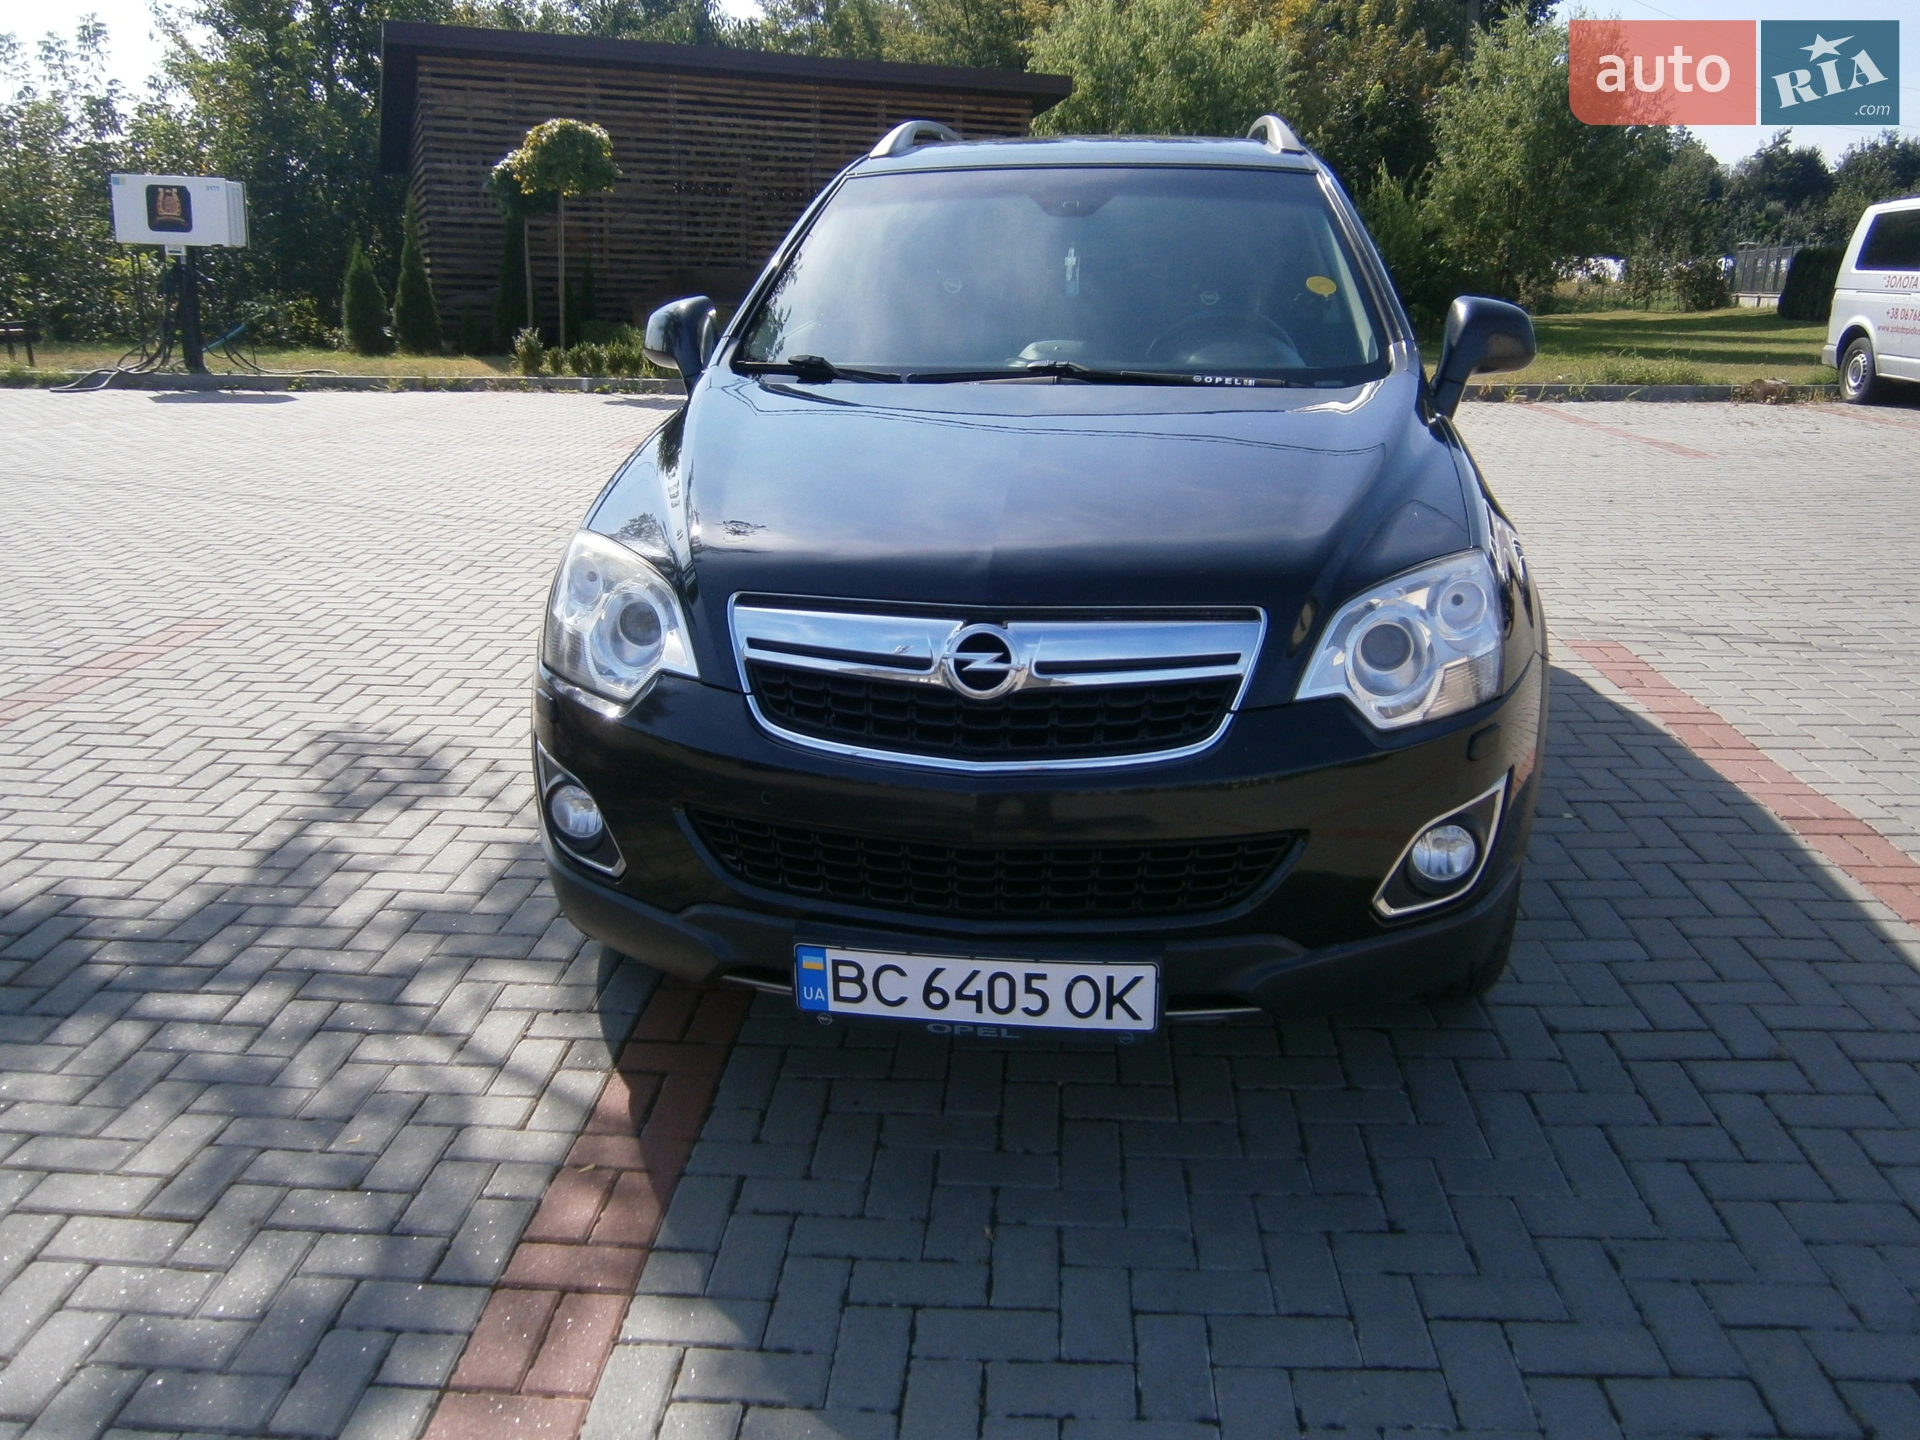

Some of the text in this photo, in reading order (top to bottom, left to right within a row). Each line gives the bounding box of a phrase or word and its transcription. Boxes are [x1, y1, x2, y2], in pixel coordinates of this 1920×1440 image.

[1886, 307, 1899, 320] +38
[1204, 376, 1242, 386] OPEL
[803, 986, 826, 1002] UA
[831, 958, 1145, 1021] BC 6405 OK
[926, 1023, 1020, 1039] OPEL
